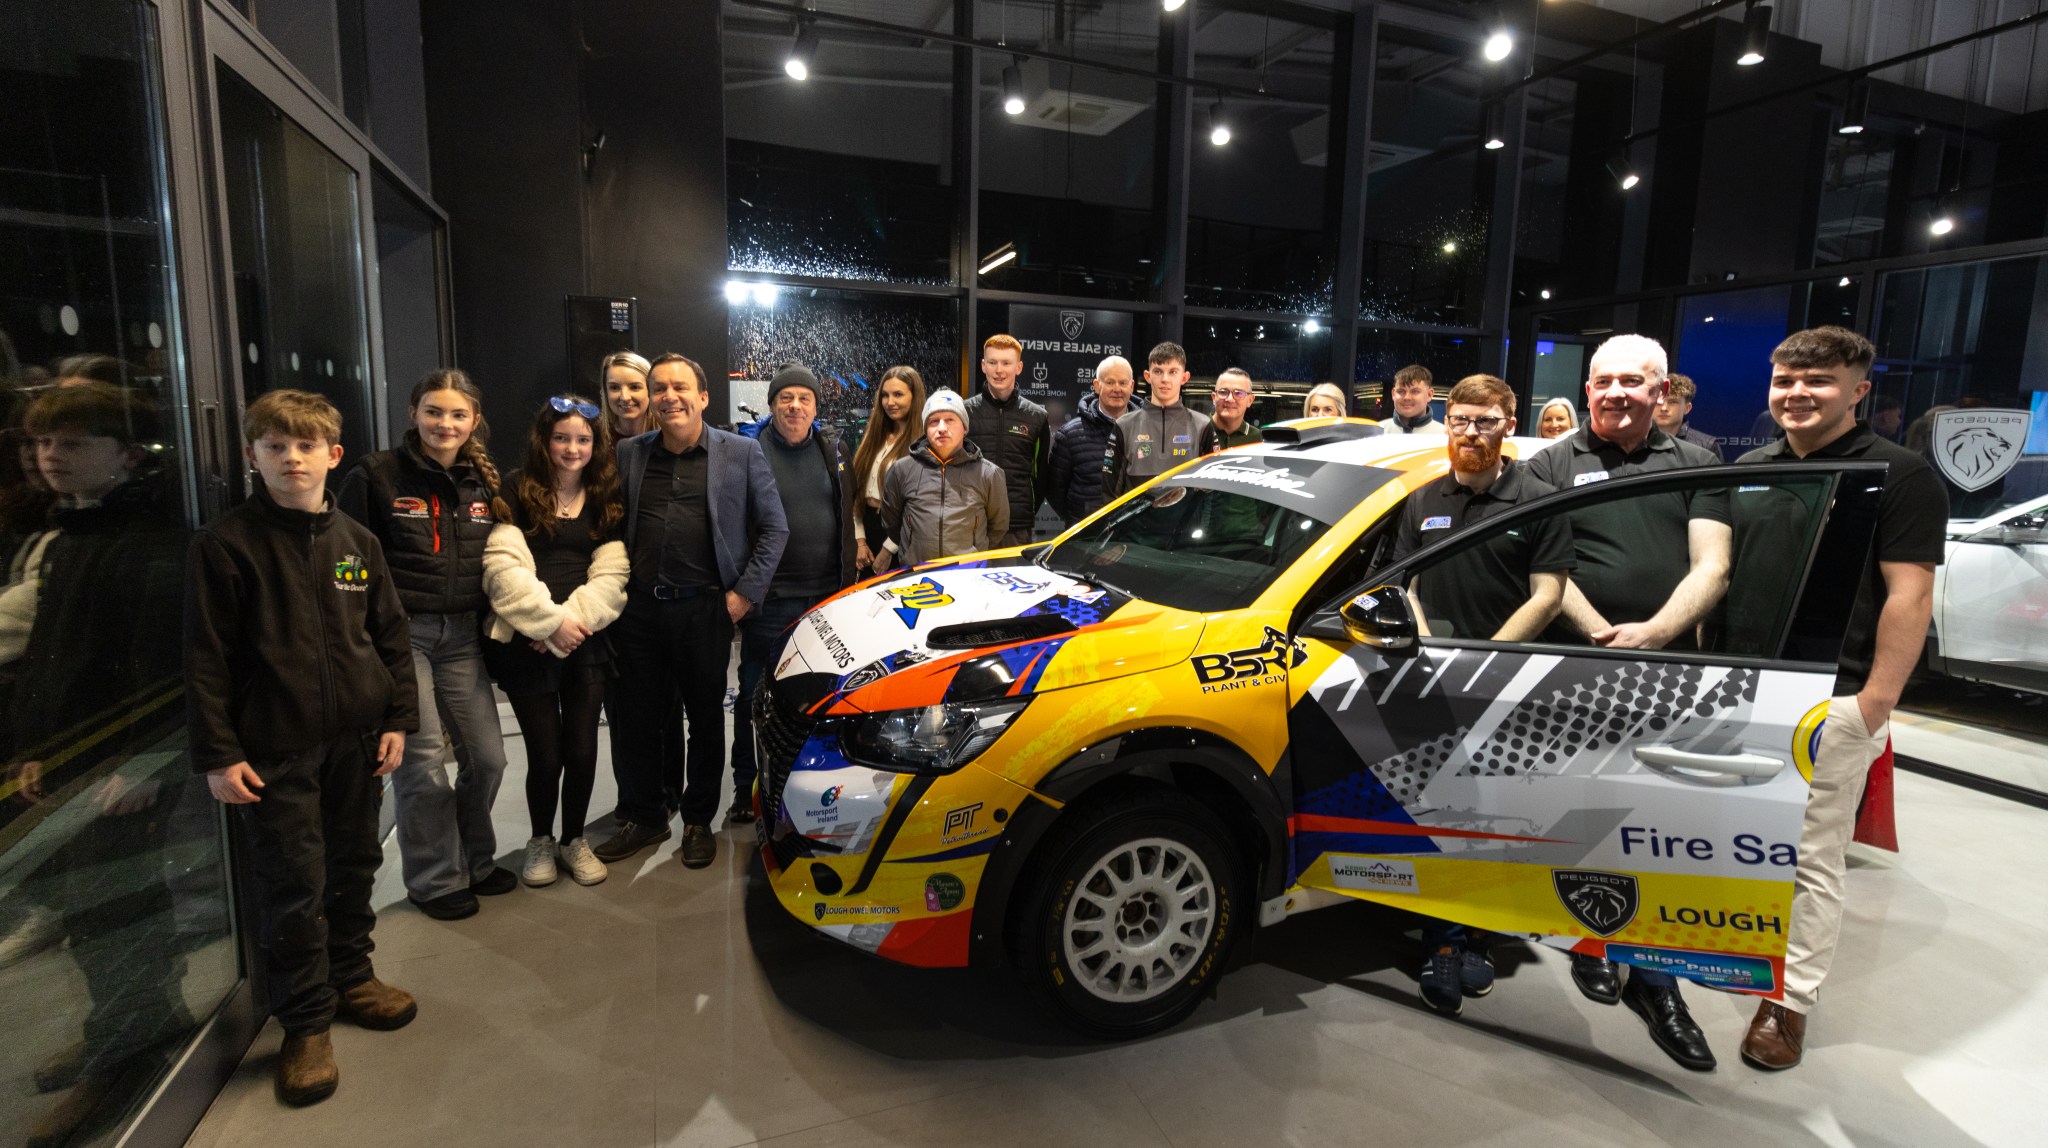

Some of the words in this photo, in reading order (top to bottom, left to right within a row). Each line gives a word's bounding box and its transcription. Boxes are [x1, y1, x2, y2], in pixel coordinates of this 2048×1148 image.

[823, 633, 855, 669] MOTORS
[1202, 679, 1248, 695] PLANT
[1252, 678, 1261, 687] &
[806, 806, 838, 818] Motorsport
[817, 813, 838, 824] Ireland
[1620, 826, 1713, 861] Fire
[1560, 873, 1630, 887] PEUGEOT
[825, 906, 848, 915] LOUGH
[849, 906, 868, 914] OWEL
[869, 905, 900, 914] MOTORS
[1659, 906, 1782, 935] LOUGH
[1632, 952, 1687, 966] Sligo
[1686, 963, 1752, 977] Pallets
